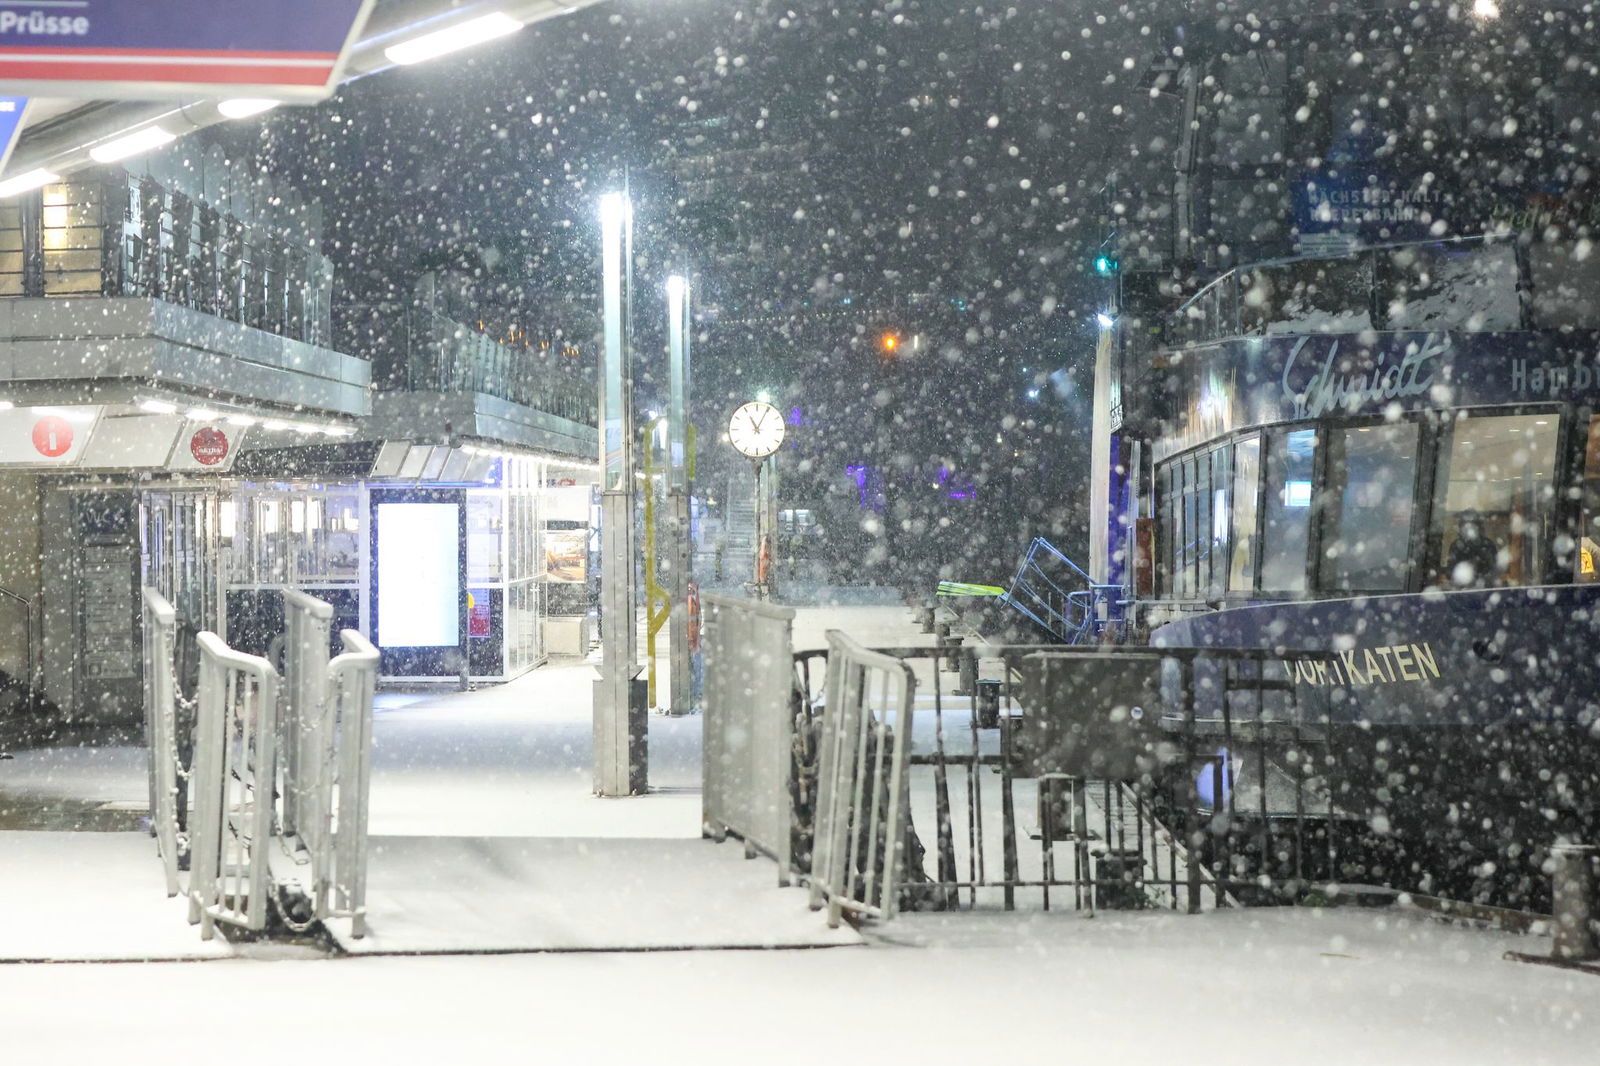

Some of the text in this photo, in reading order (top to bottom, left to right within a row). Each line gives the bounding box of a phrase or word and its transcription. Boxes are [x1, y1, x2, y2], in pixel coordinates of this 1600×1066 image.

[0, 10, 90, 36] Prüsse
[1310, 207, 1414, 221] REPERBAHN
[1282, 332, 1452, 420] Schmidt
[85, 509, 110, 524] WC
